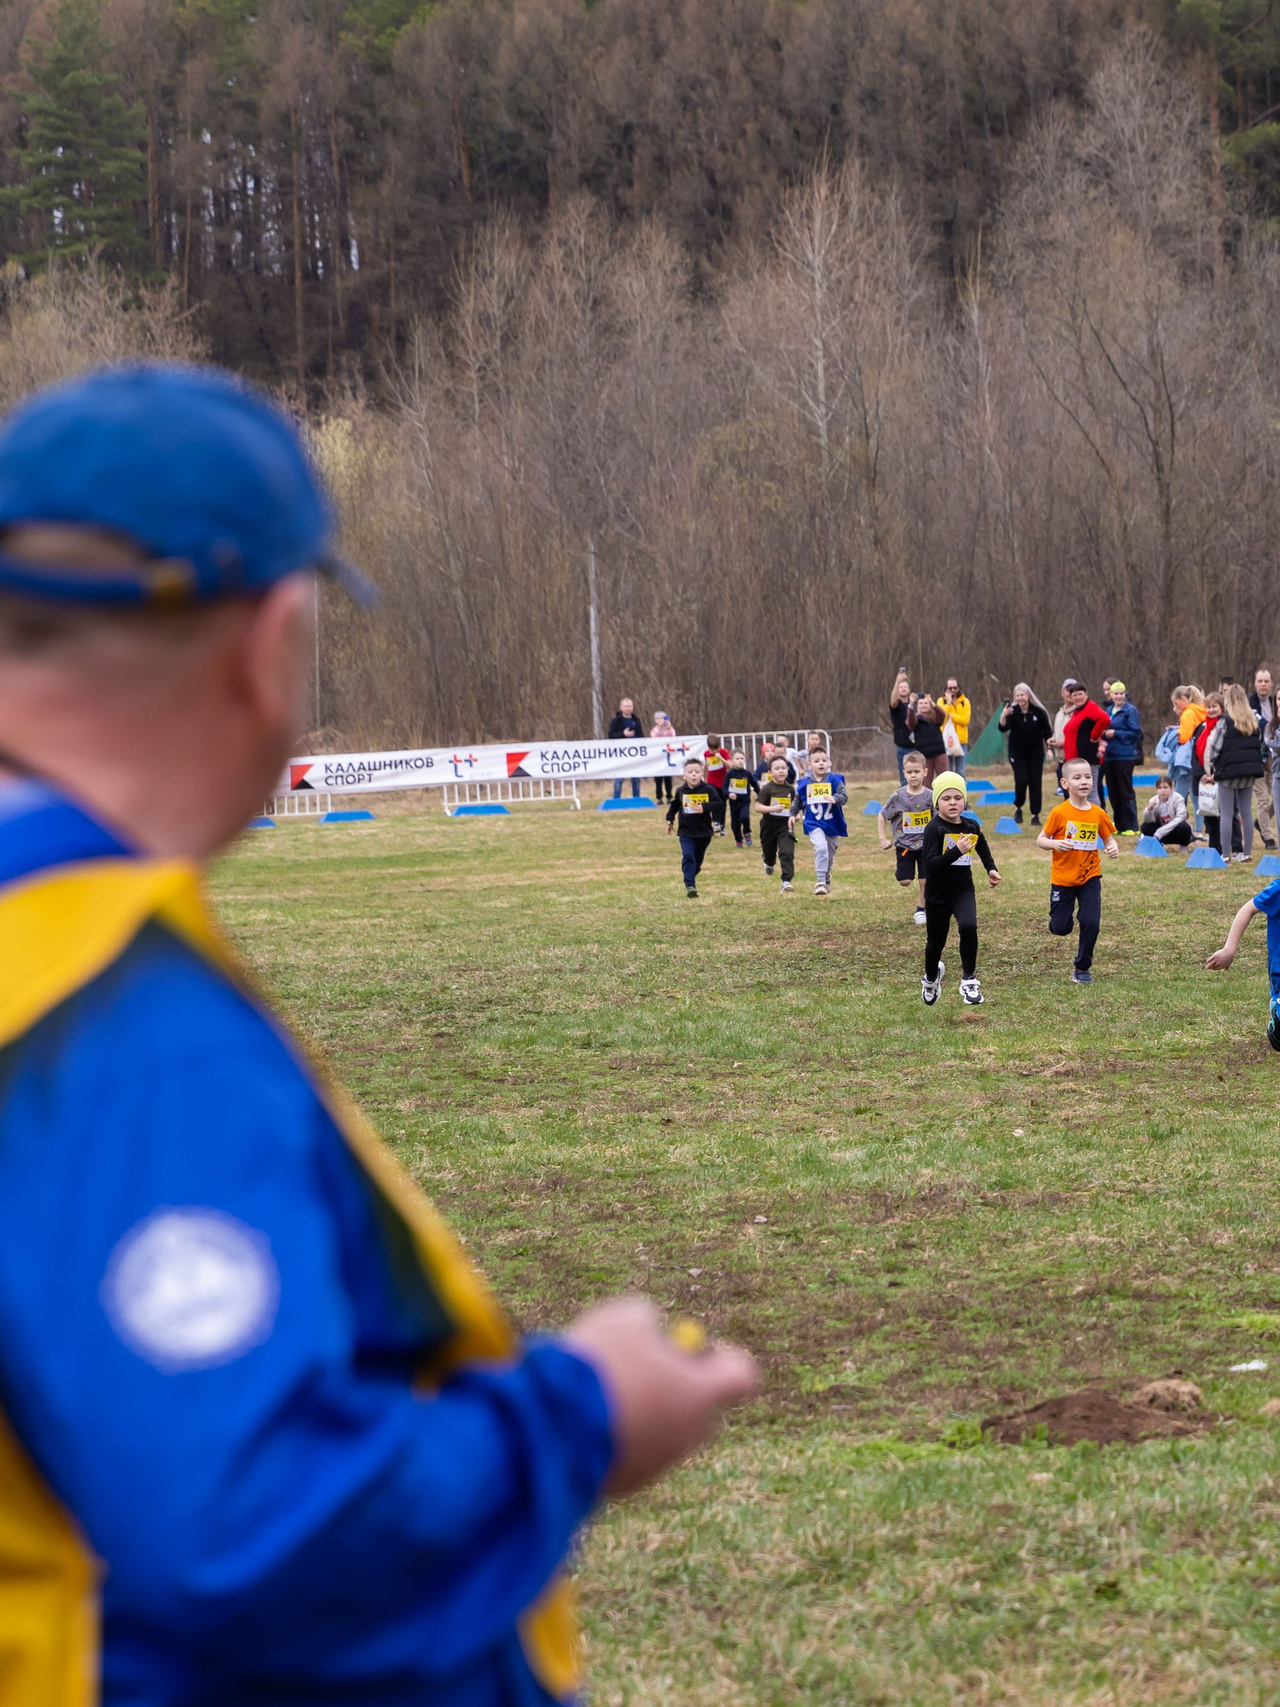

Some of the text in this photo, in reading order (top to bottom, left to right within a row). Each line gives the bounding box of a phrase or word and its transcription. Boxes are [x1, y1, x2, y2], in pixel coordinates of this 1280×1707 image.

[540, 746, 648, 762] КАЛАШНИКОВ
[324, 757, 434, 774] КАЛАШНИКОВ
[541, 761, 590, 774] СПОРТ
[324, 773, 375, 786] СПОРТ
[813, 788, 830, 796] 364
[914, 816, 929, 826] 519
[1079, 830, 1096, 840] 379
